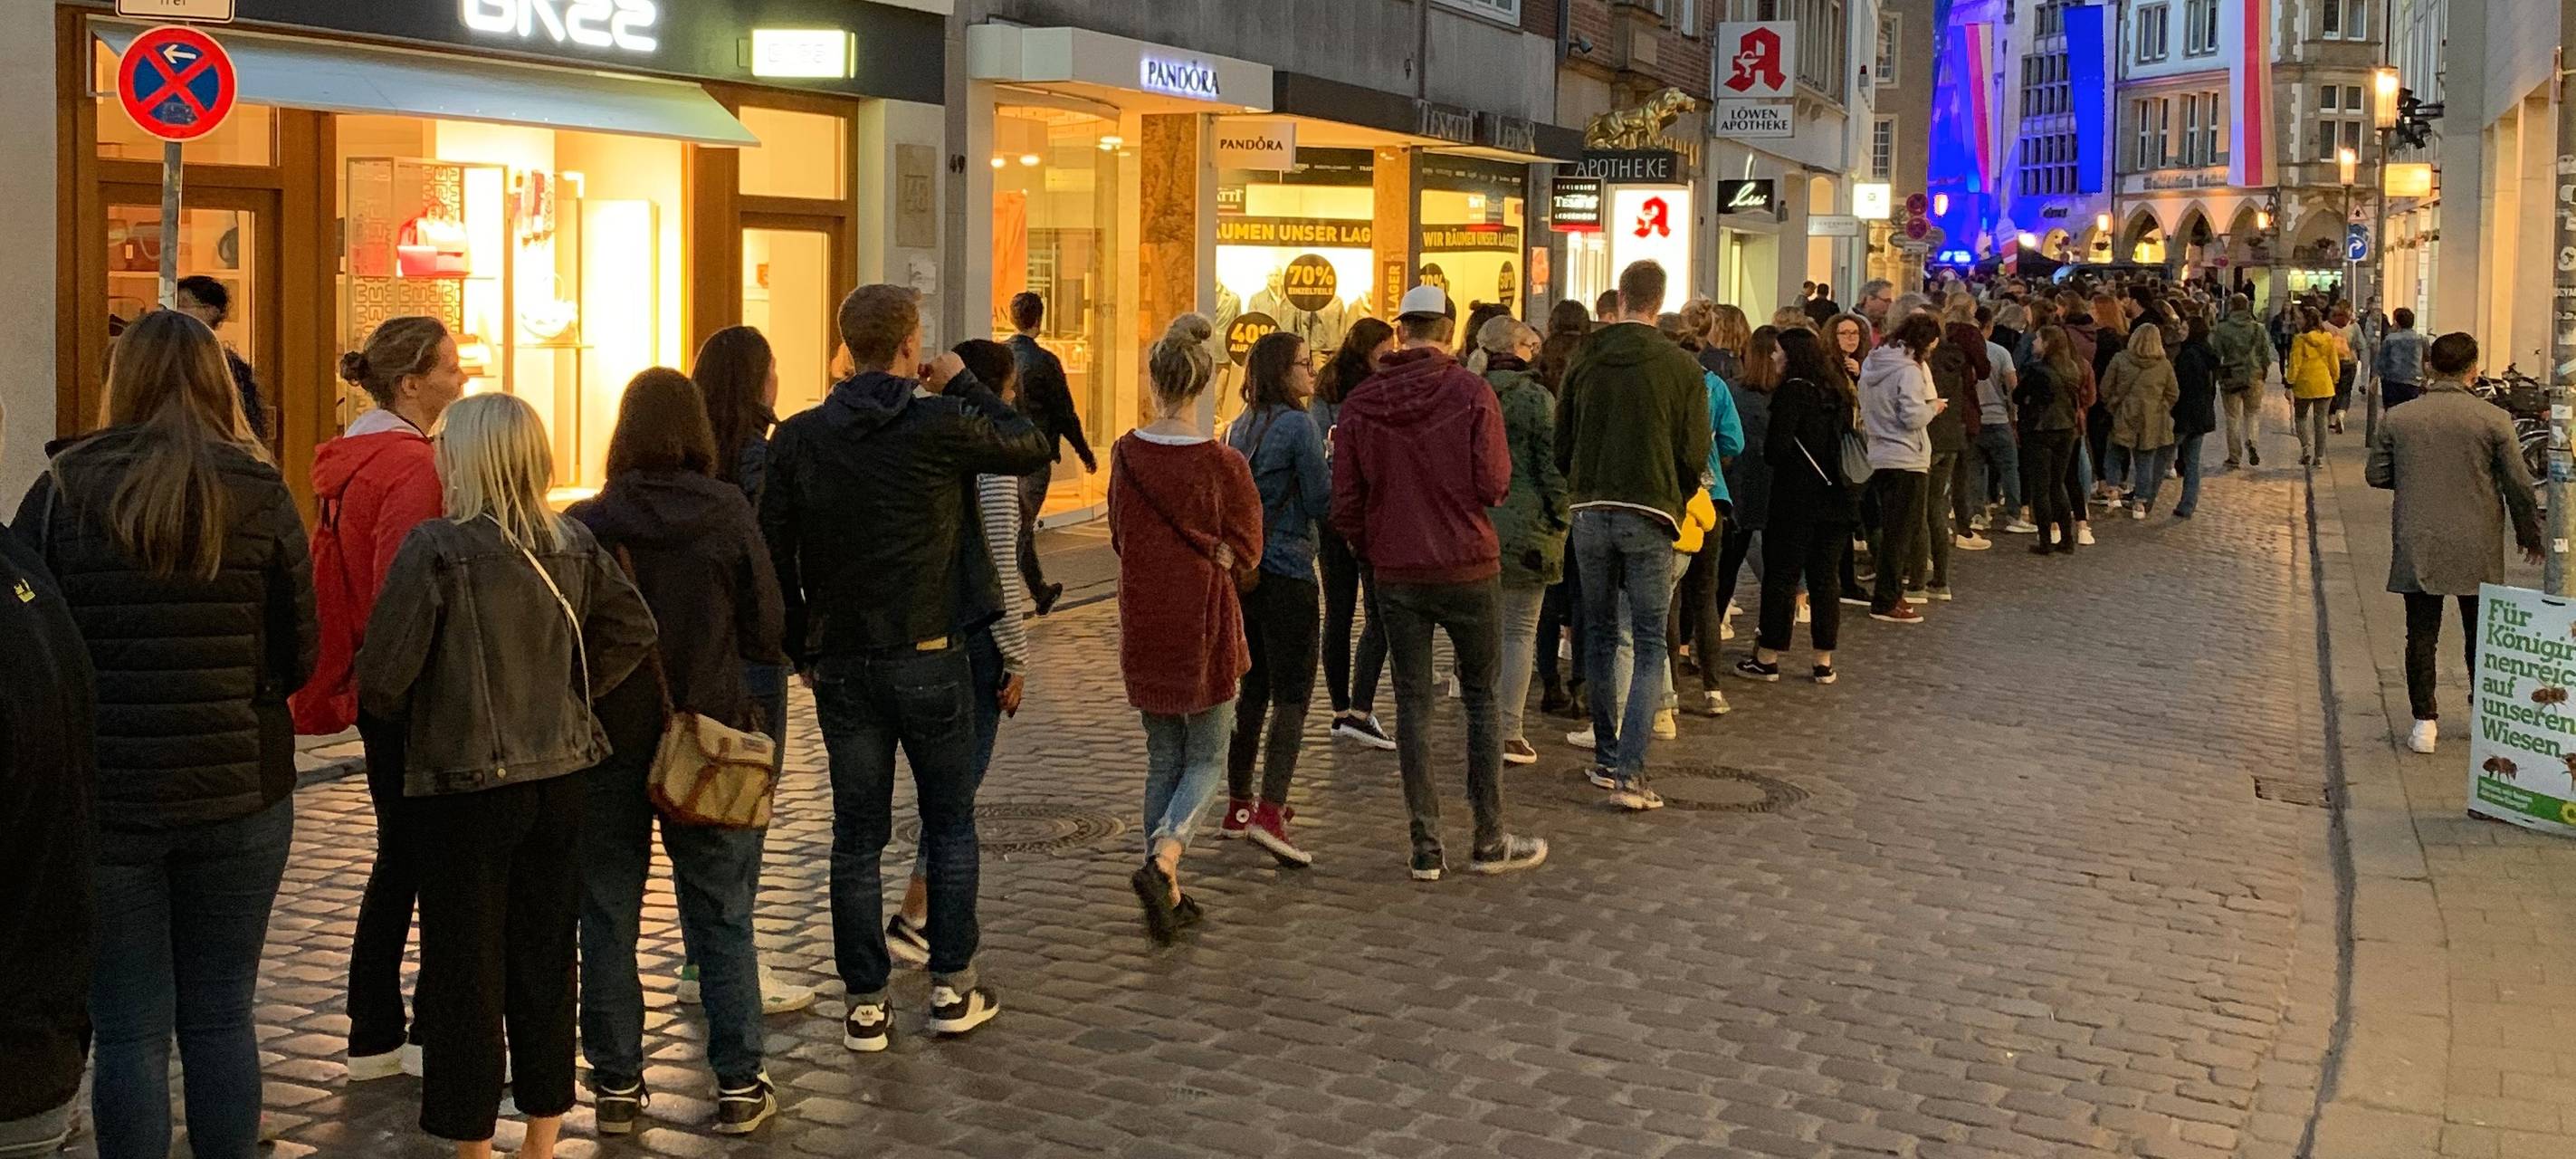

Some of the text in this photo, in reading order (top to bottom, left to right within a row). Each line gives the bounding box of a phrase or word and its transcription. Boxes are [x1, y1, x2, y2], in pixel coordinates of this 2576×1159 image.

[1148, 59, 1220, 94] PANDORA
[1731, 107, 1778, 120] LÖWEN
[1721, 120, 1788, 131] APOTHEKE
[1220, 137, 1283, 150] PANDORA
[949, 155, 966, 174] 49
[1575, 158, 1667, 177] APOTHEKE
[1279, 224, 1337, 243] UNSER
[1423, 228, 1518, 247] WIR RÄUMEN UNSER LAGER
[1289, 265, 1334, 285] 70%
[1287, 287, 1334, 296] EINZELTEILE
[1388, 265, 1400, 311] LAGER
[1229, 342, 1249, 352] AUF
[2487, 598, 2533, 627] Für
[2484, 652, 2576, 687] nenreic
[2482, 675, 2517, 698] auf
[2482, 696, 2576, 735] unseren
